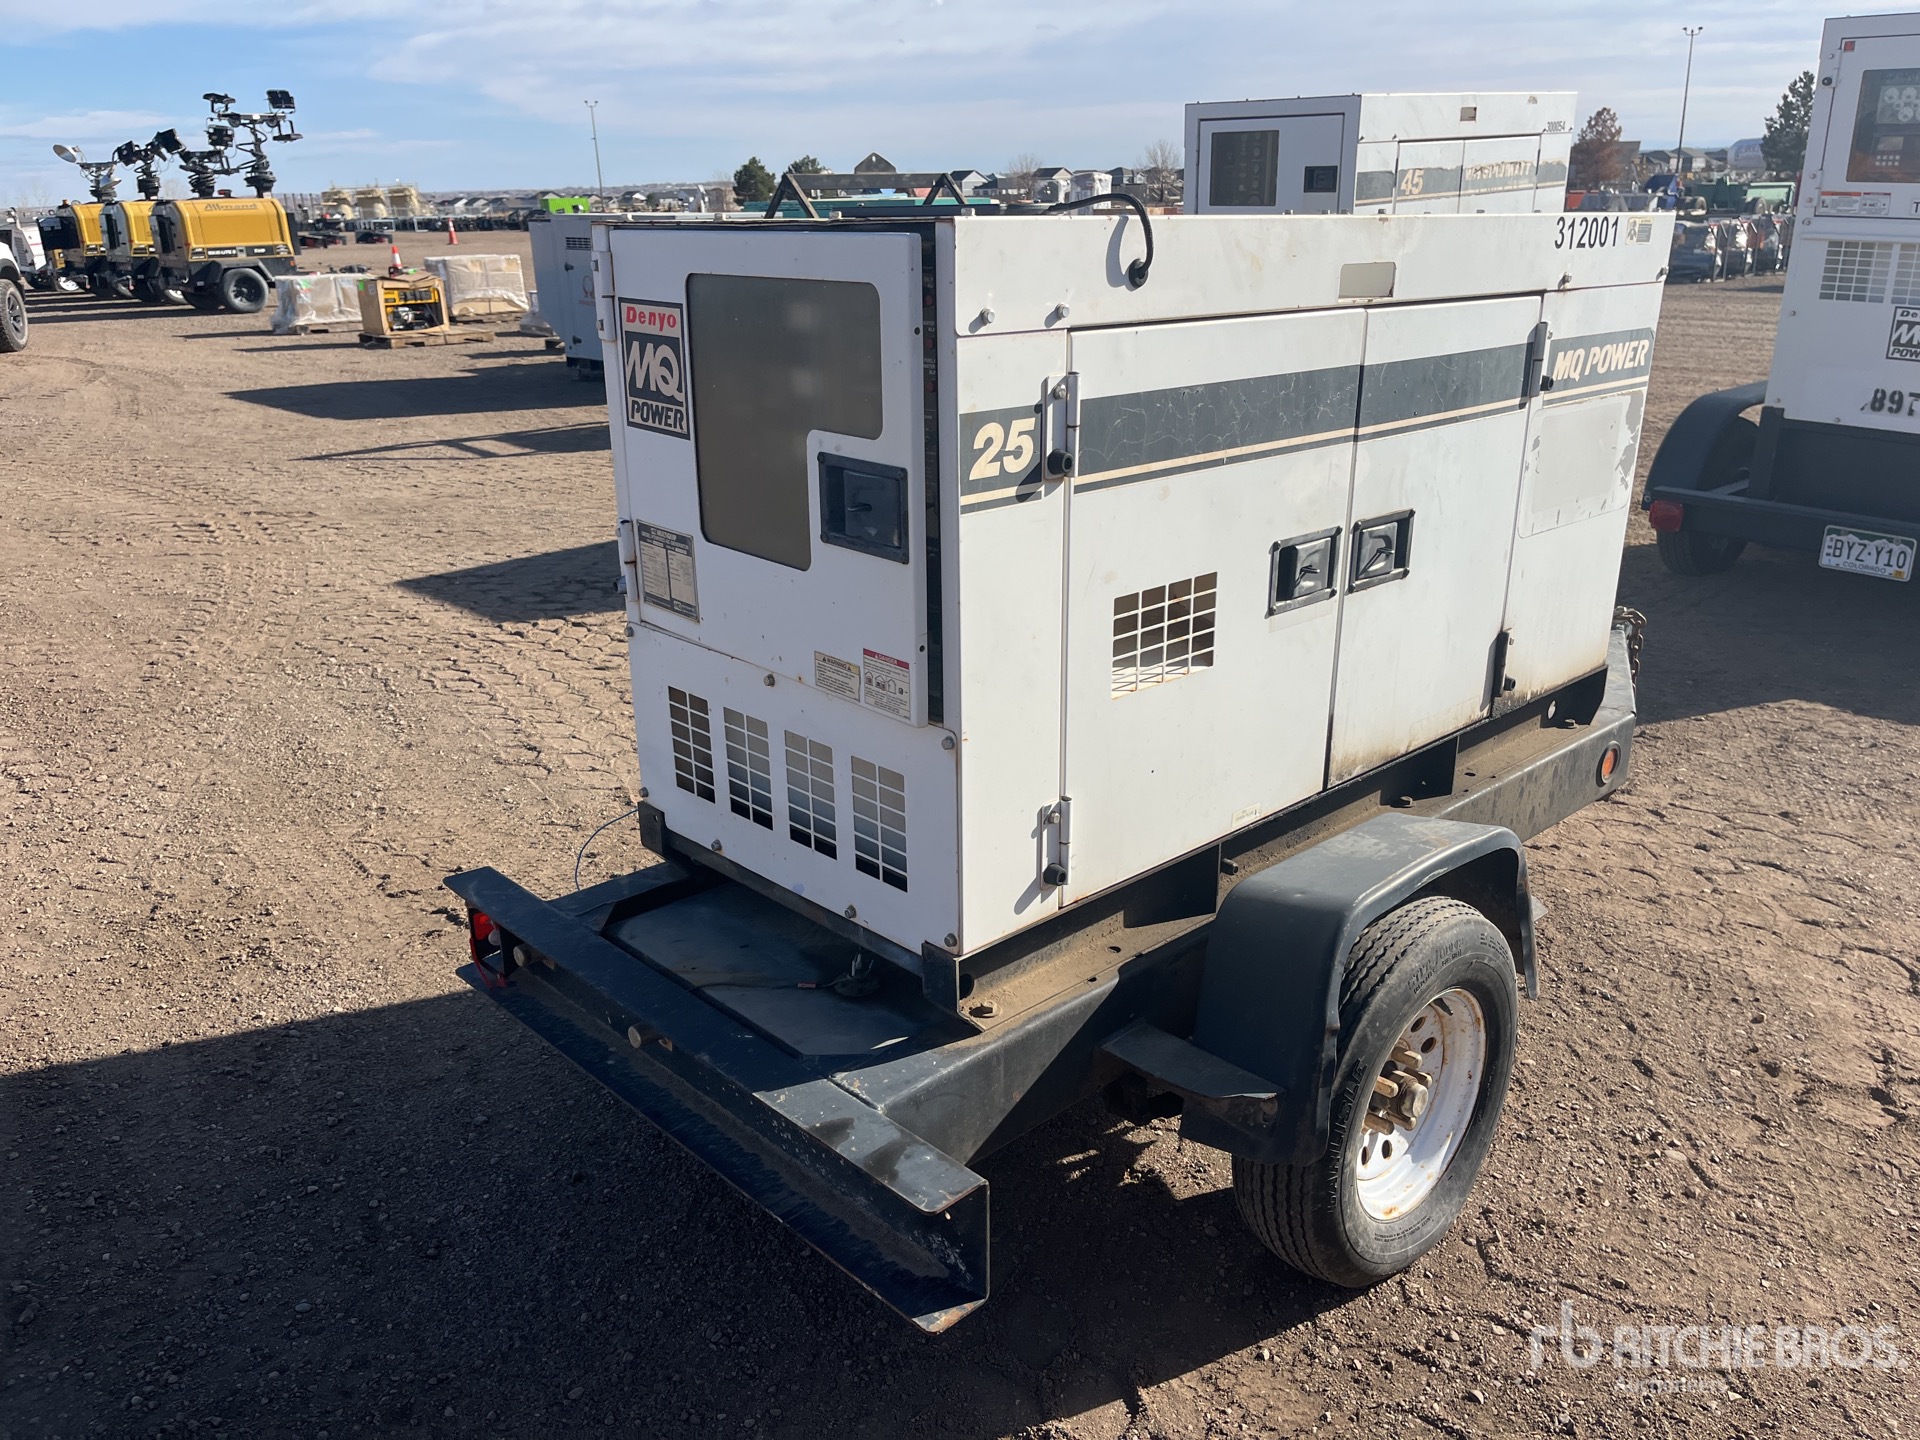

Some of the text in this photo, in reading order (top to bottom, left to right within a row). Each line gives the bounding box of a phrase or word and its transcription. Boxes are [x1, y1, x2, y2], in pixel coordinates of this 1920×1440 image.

[1401, 169, 1424, 195] 45
[1554, 216, 1619, 250] 312001
[626, 306, 677, 332] Denyo
[626, 340, 684, 402] MQ
[1553, 339, 1650, 383] MQ POWER
[631, 400, 684, 431] POWER
[968, 417, 1036, 481] 25
[1842, 561, 1887, 574] COLORADO
[827, 657, 847, 670] WARNING
